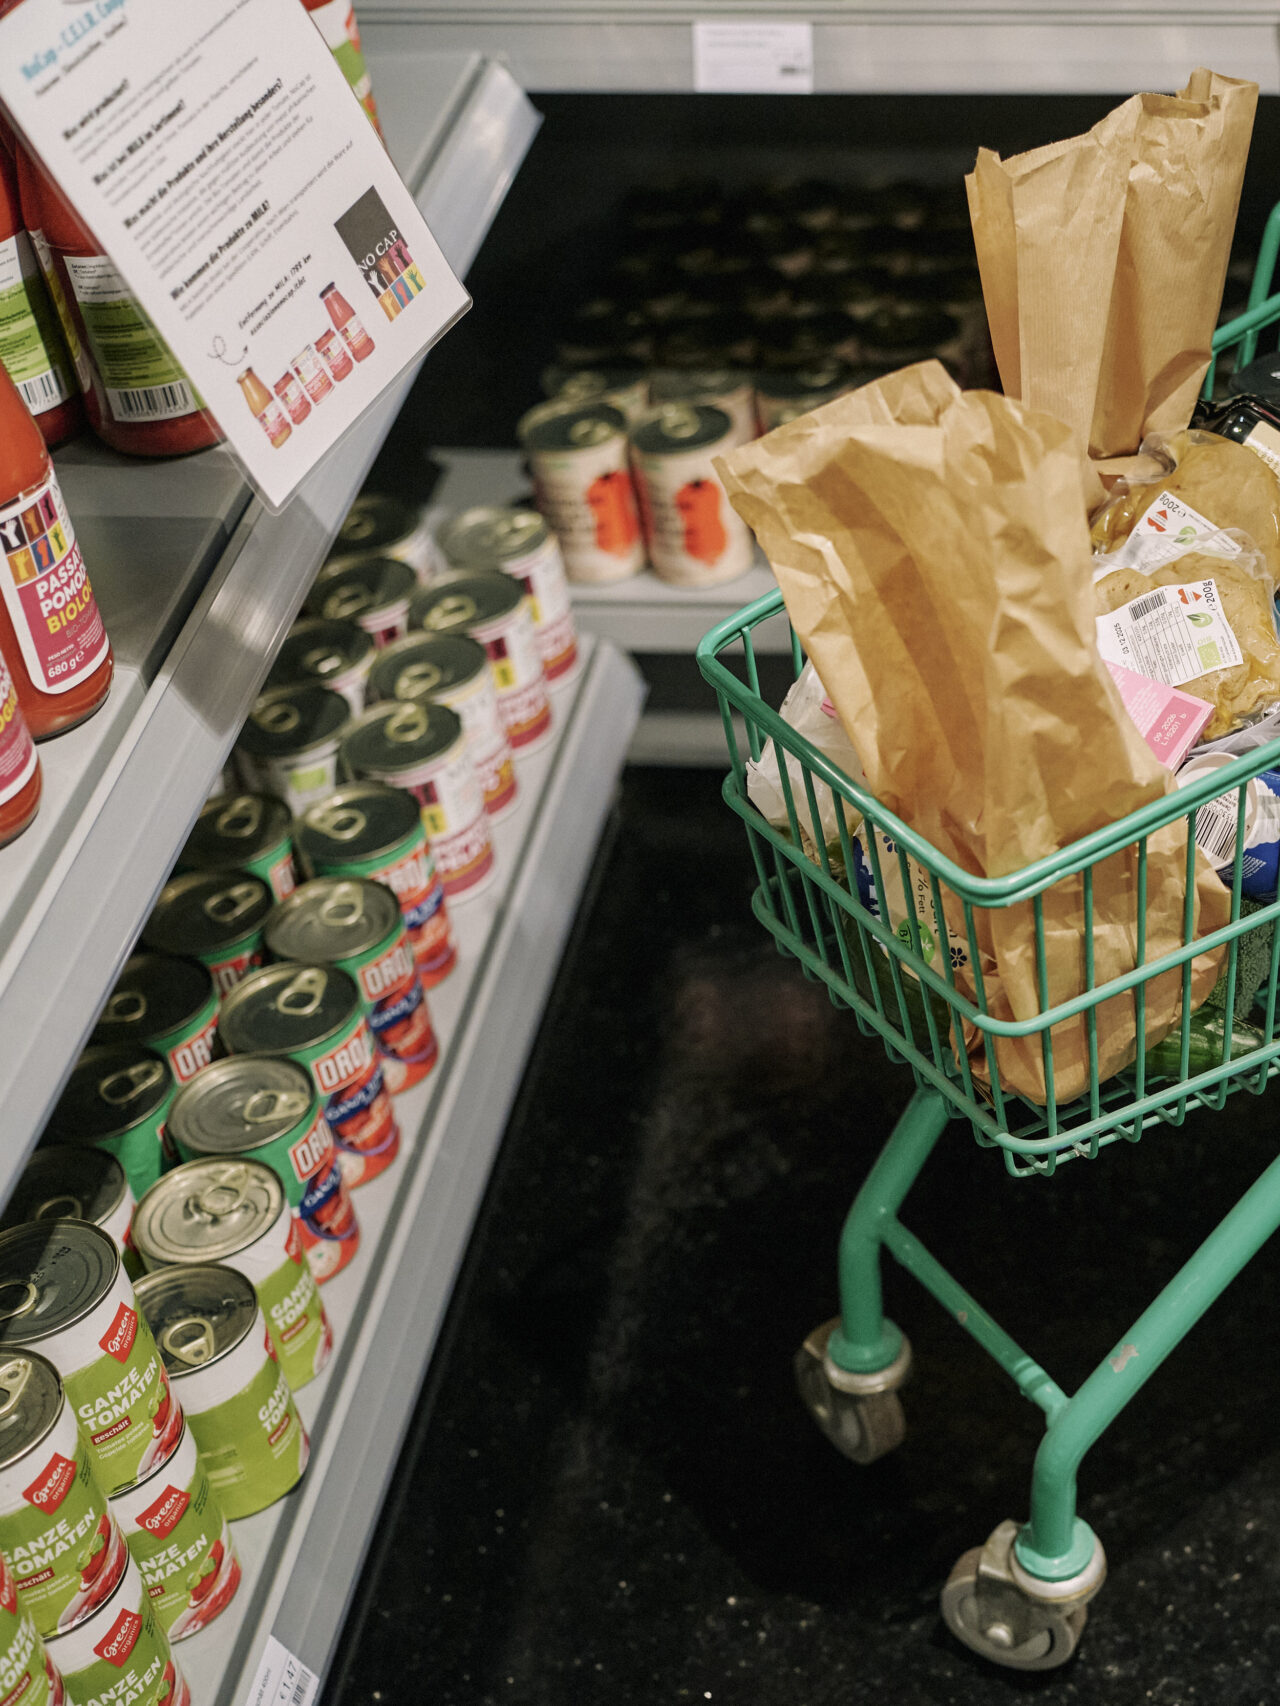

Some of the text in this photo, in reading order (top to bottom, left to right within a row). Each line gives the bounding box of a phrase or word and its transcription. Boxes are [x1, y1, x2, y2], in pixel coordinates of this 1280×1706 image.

[167, 160, 194, 188] Produkte
[251, 79, 282, 111] besonders?
[218, 225, 245, 253] Produkte
[250, 200, 271, 221] MILA?
[358, 230, 399, 273] NO CAP
[1157, 492, 1180, 513] 200g
[1200, 579, 1217, 604] 200g
[48, 663, 68, 678] 680
[1161, 711, 1177, 730] 2026
[917, 894, 926, 913] Fett
[108, 1310, 132, 1353] Green
[123, 1315, 136, 1349] organics
[78, 1365, 141, 1419] GANZE
[83, 1355, 159, 1432] TOMATEN
[93, 1418, 131, 1445] geschält
[33, 1461, 67, 1504] Green
[52, 1466, 73, 1501] organics
[145, 1491, 180, 1529] Green
[164, 1497, 186, 1527] organics
[9, 1507, 96, 1575] OMATEN
[140, 1543, 181, 1573] NZE
[144, 1533, 208, 1586] MATEN
[16, 1570, 52, 1590] eschält
[104, 1616, 134, 1658] Green
[121, 1620, 139, 1653] organics
